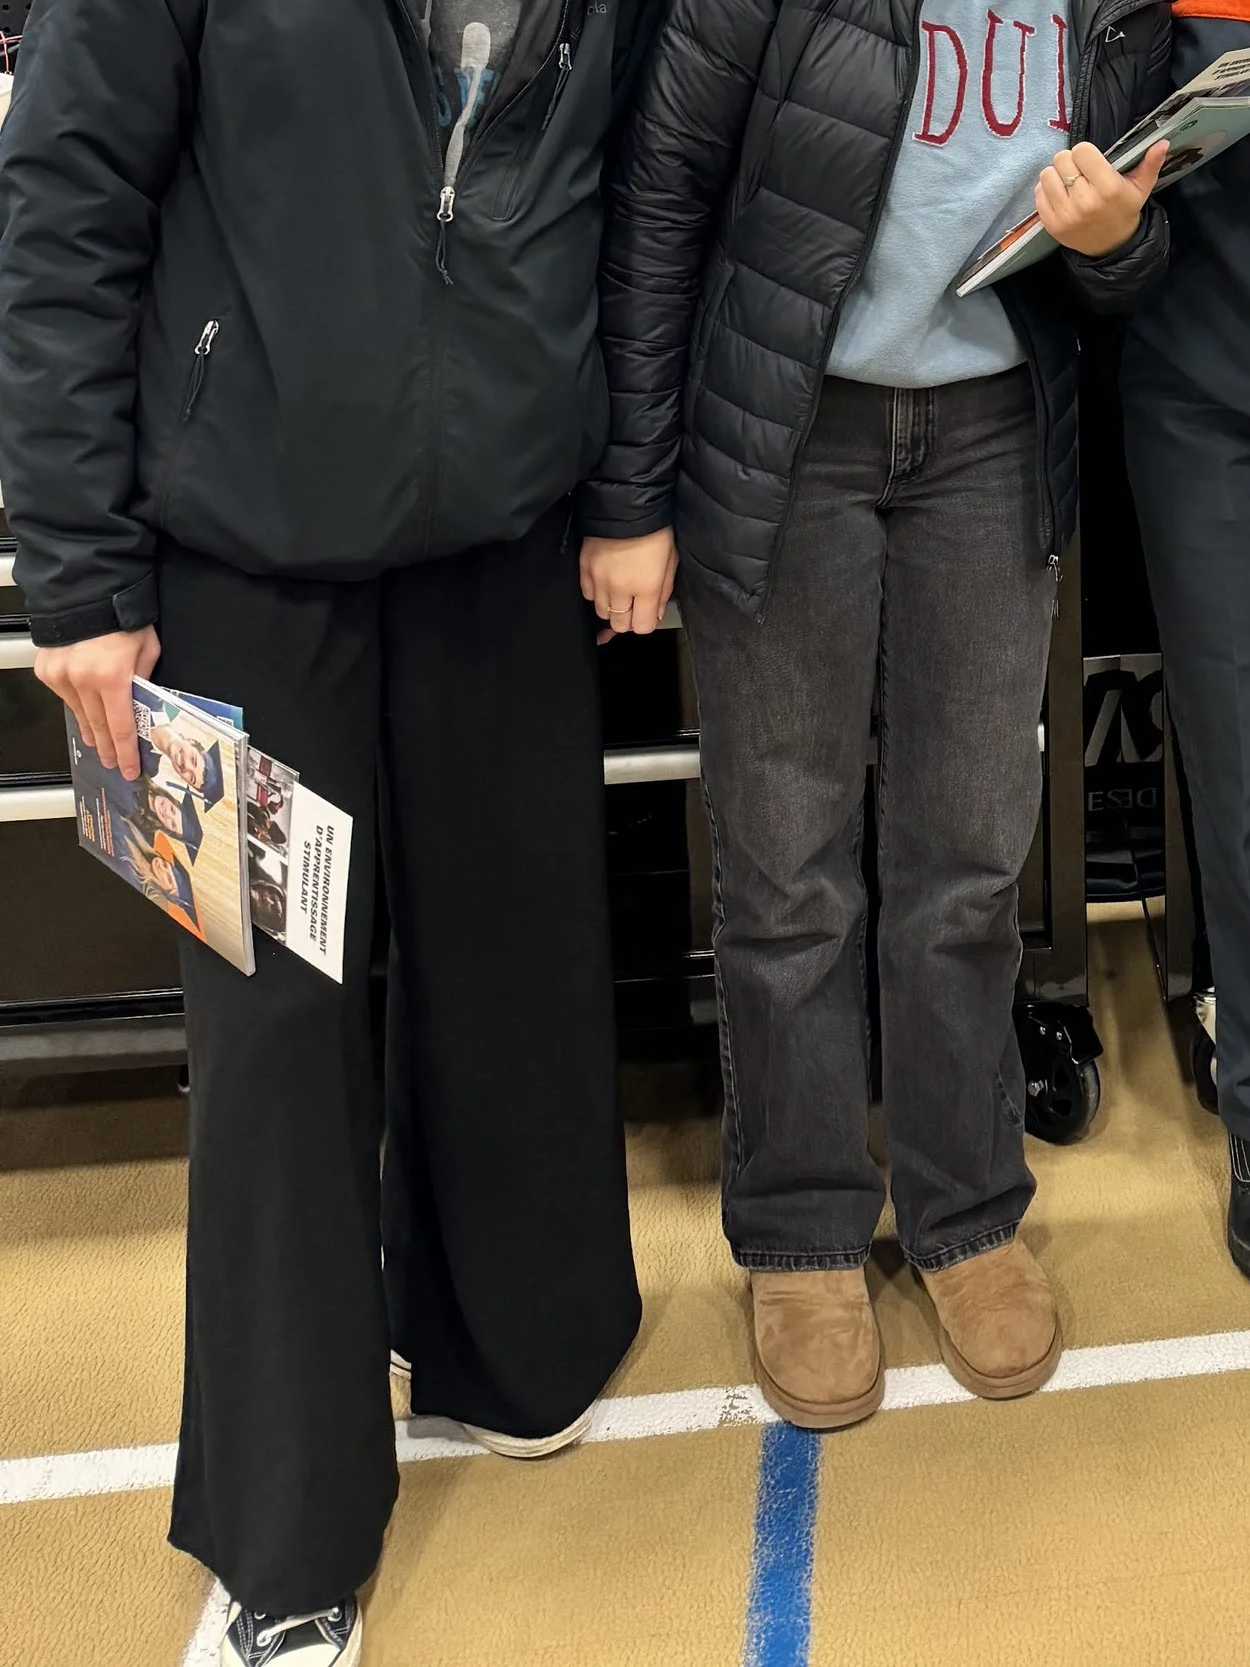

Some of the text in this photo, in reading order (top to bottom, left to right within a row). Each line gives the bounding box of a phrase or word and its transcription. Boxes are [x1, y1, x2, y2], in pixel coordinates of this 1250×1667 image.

[300, 840, 311, 914] STIMULANT
[319, 825, 335, 955] UN ENVIRONNEMENT
